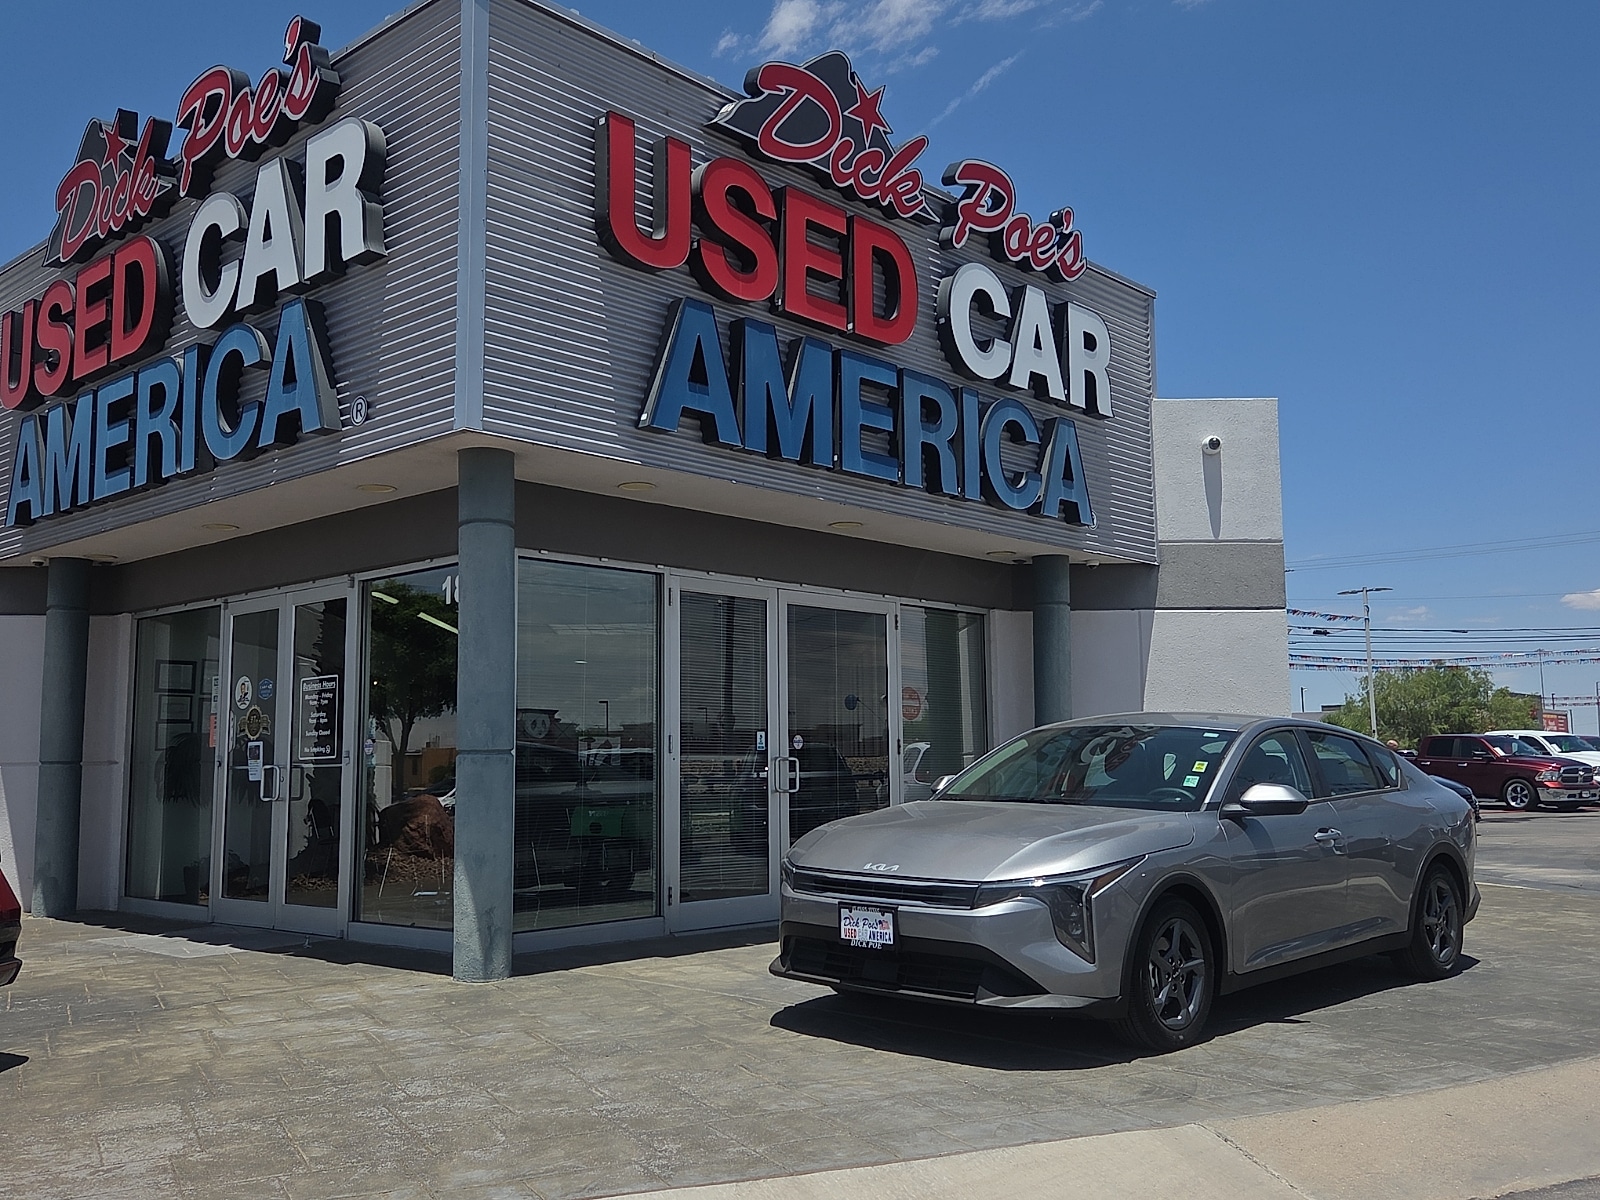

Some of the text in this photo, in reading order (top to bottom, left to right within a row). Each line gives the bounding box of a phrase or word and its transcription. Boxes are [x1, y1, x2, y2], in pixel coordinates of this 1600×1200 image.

[55, 15, 322, 263] Dick Poe's
[757, 61, 1088, 283] Dick Poe's
[0, 116, 374, 410] USED CAR
[602, 110, 1115, 418] USED CAR
[5, 298, 326, 527] AMERICA
[646, 297, 1094, 527] AMERICA
[322, 680, 335, 688] Hours
[844, 927, 857, 939] USED
[868, 930, 892, 943] AMERICA
[850, 939, 882, 950] DICK POE
